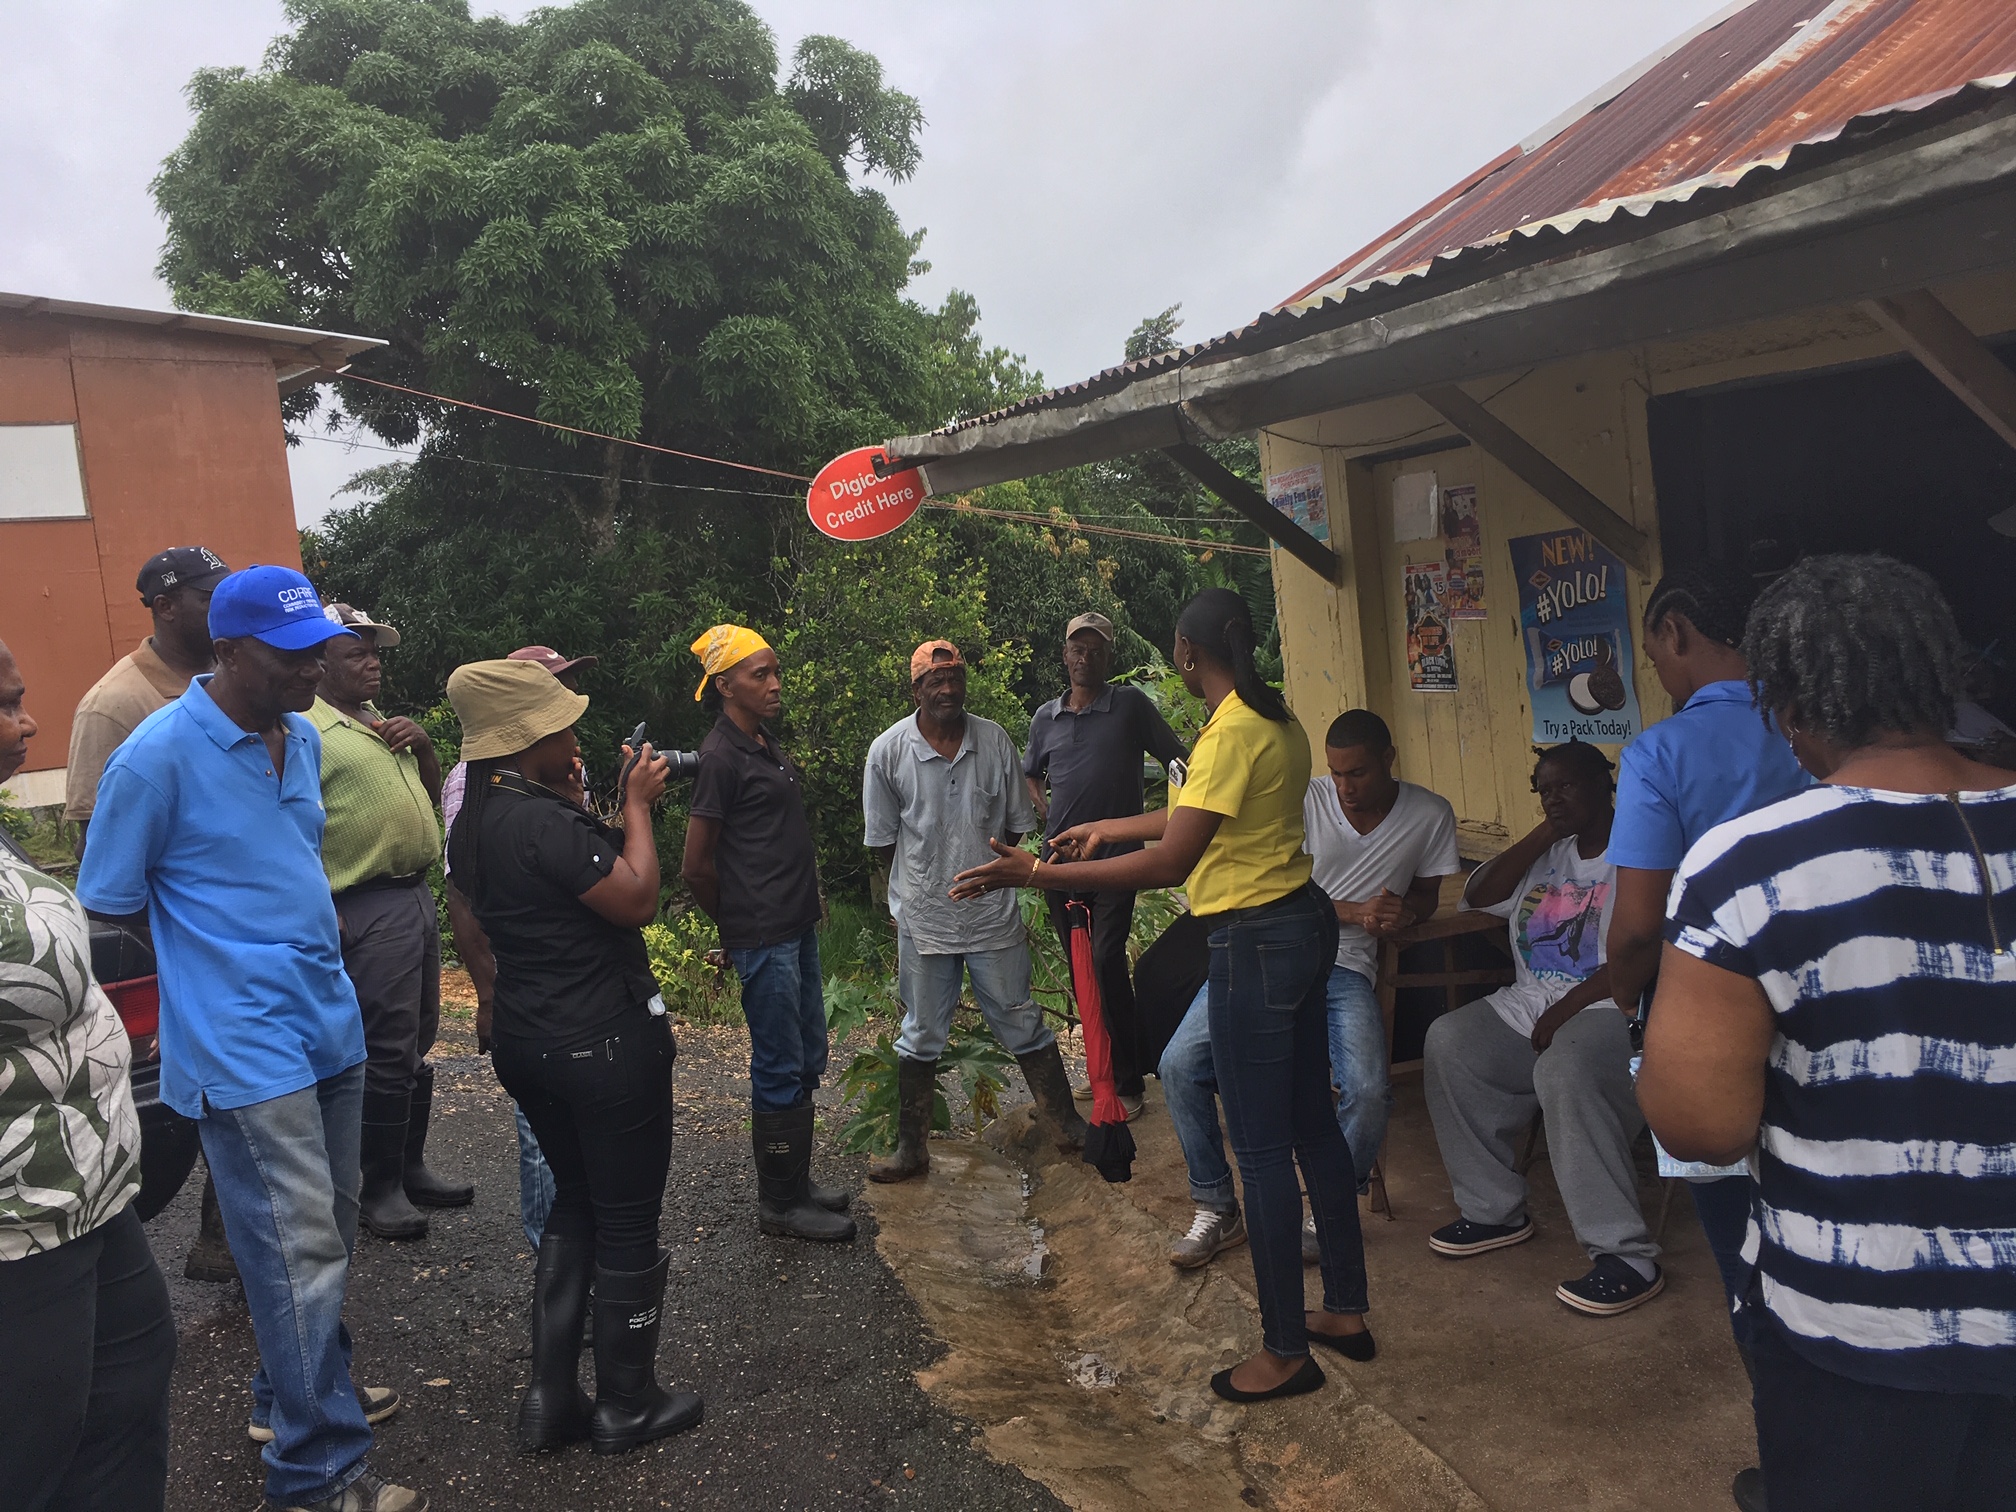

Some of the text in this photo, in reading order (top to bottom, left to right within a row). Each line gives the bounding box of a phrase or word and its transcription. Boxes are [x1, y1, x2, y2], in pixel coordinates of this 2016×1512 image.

[829, 472, 892, 501] Digic
[1294, 491, 1306, 503] Fun
[826, 487, 914, 529] Credit Here
[1541, 533, 1595, 567] NEW!
[161, 570, 178, 587] M
[1435, 581, 1444, 592] 15
[1536, 565, 1607, 623] #YOLO!
[1552, 635, 1598, 676] #YOLO!
[1543, 719, 1632, 740] Try a Pack Today!
